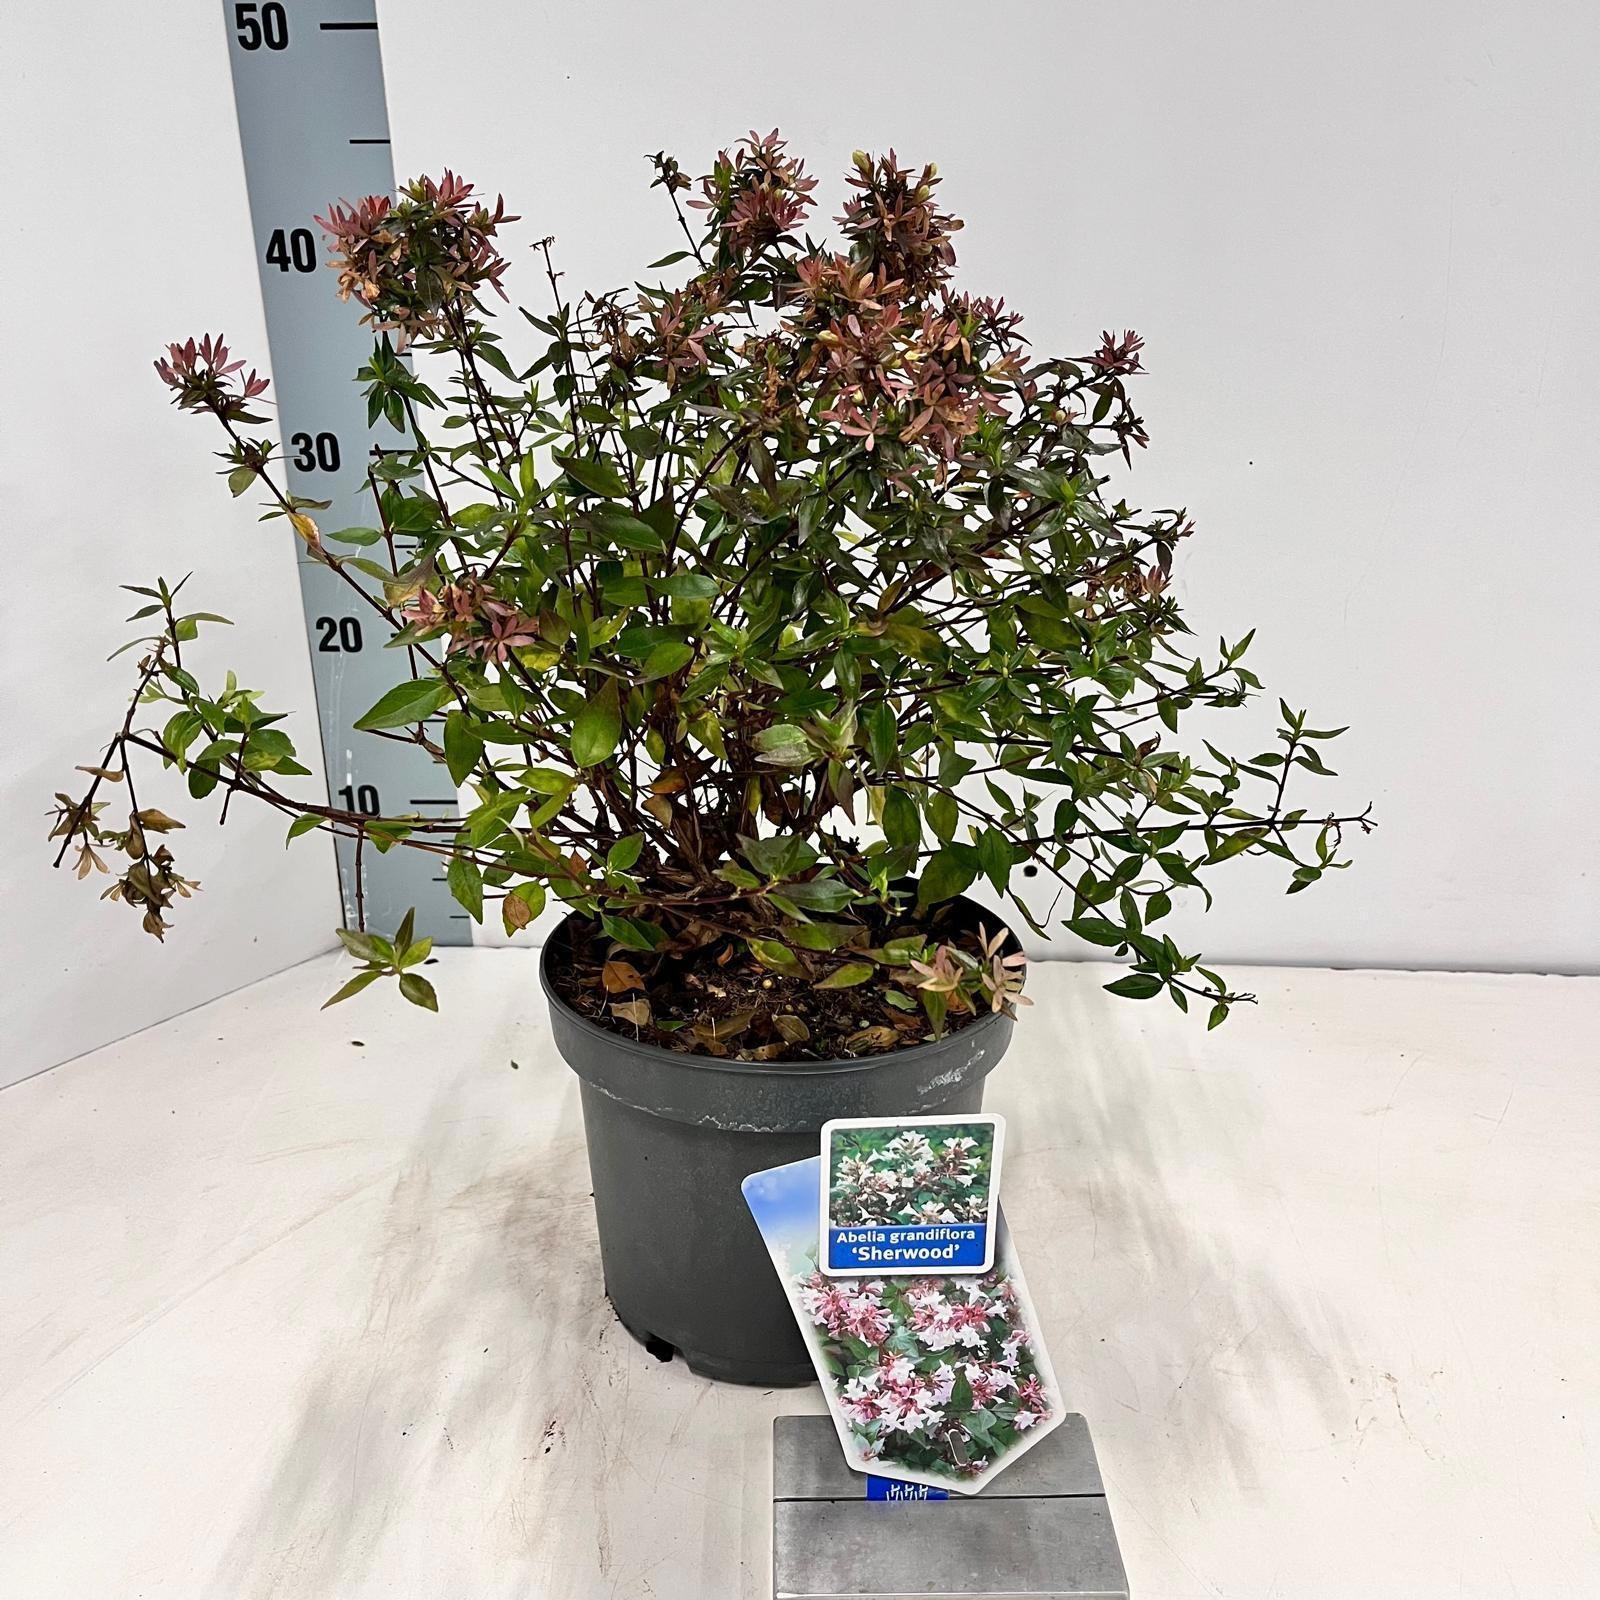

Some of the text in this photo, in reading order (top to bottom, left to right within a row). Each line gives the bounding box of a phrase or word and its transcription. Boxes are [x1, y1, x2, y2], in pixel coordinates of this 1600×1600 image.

[235, 2, 289, 51] 50
[266, 228, 317, 273] 40
[291, 432, 341, 472] 30
[316, 617, 363, 653] 20
[338, 785, 380, 816] 10
[837, 1228, 976, 1244] Abelia grandiflora
[851, 1244, 960, 1261] ‘Sherwood’
